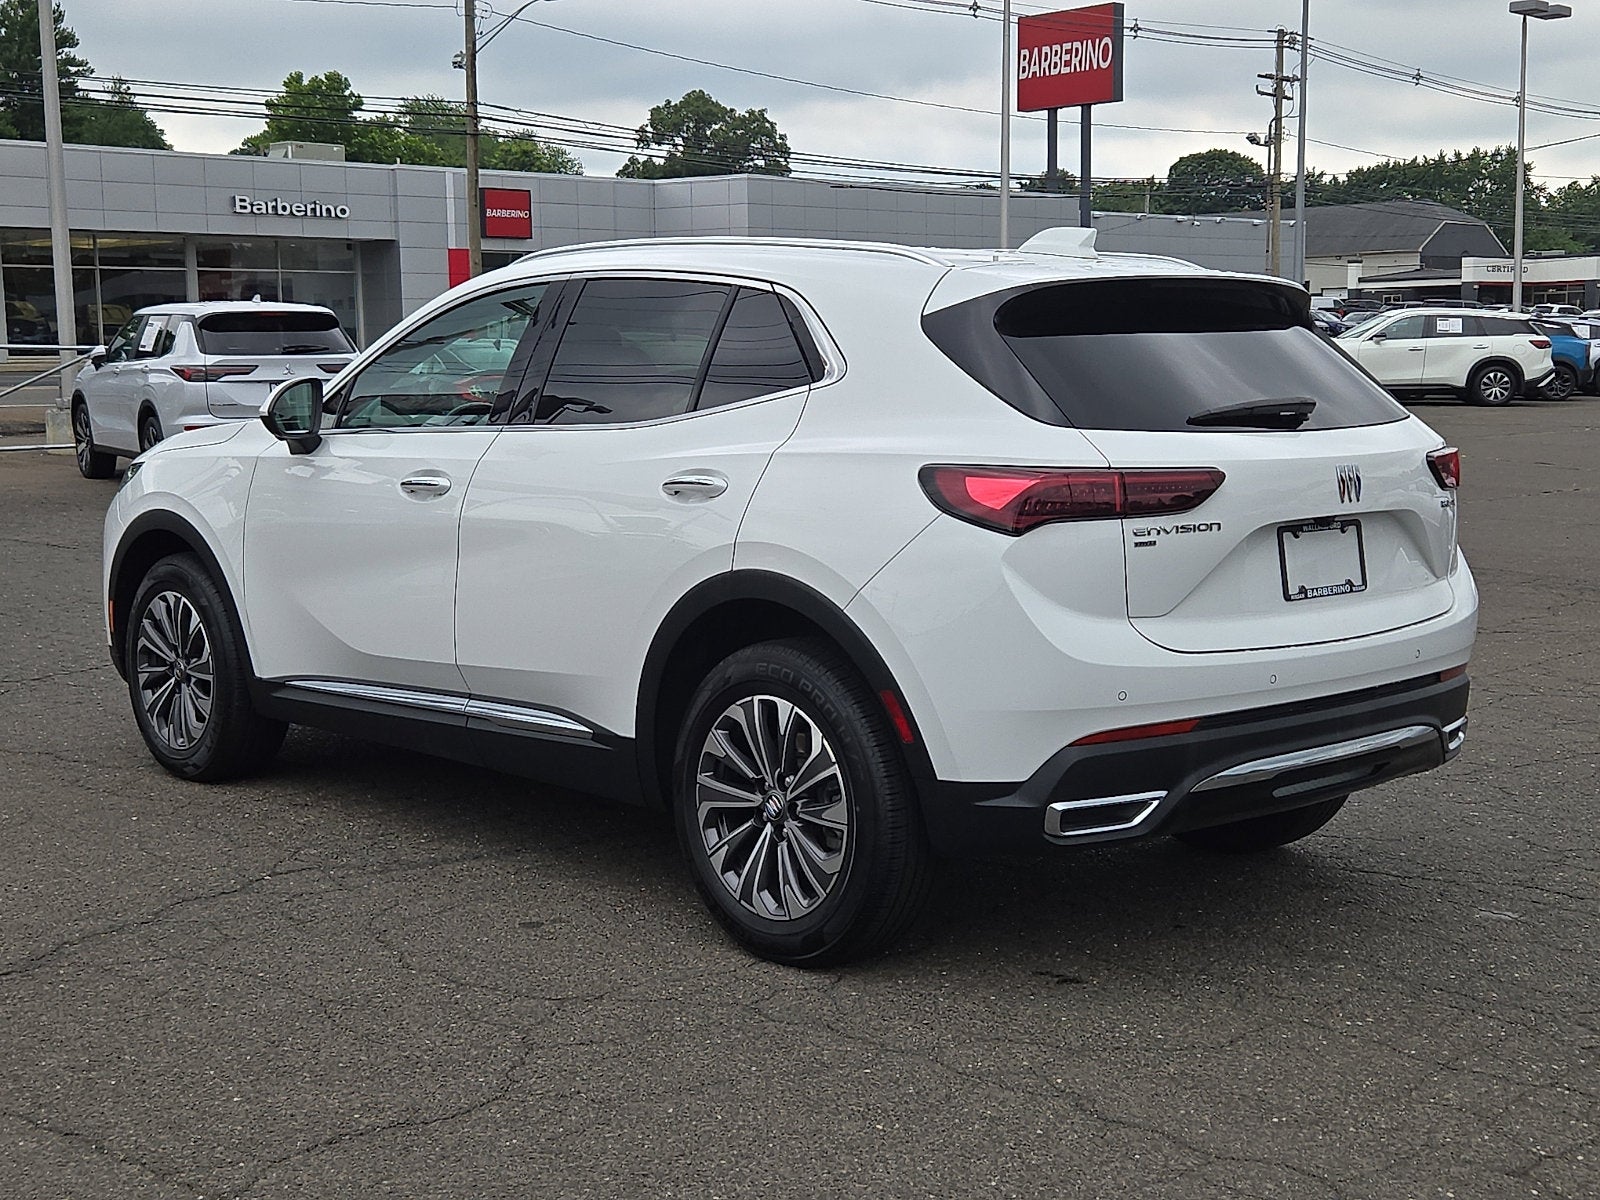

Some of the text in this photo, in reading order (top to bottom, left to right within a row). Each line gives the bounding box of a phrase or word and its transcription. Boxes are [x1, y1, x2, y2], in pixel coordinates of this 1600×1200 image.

[1019, 36, 1113, 80] BARBERINO
[234, 195, 350, 218] Barberino
[486, 208, 530, 219] BARBERINO
[1486, 264, 1529, 274] CERTIFD
[1132, 522, 1222, 537] ENVISION
[1307, 584, 1351, 598] BARBERINO
[755, 662, 795, 683] ECO
